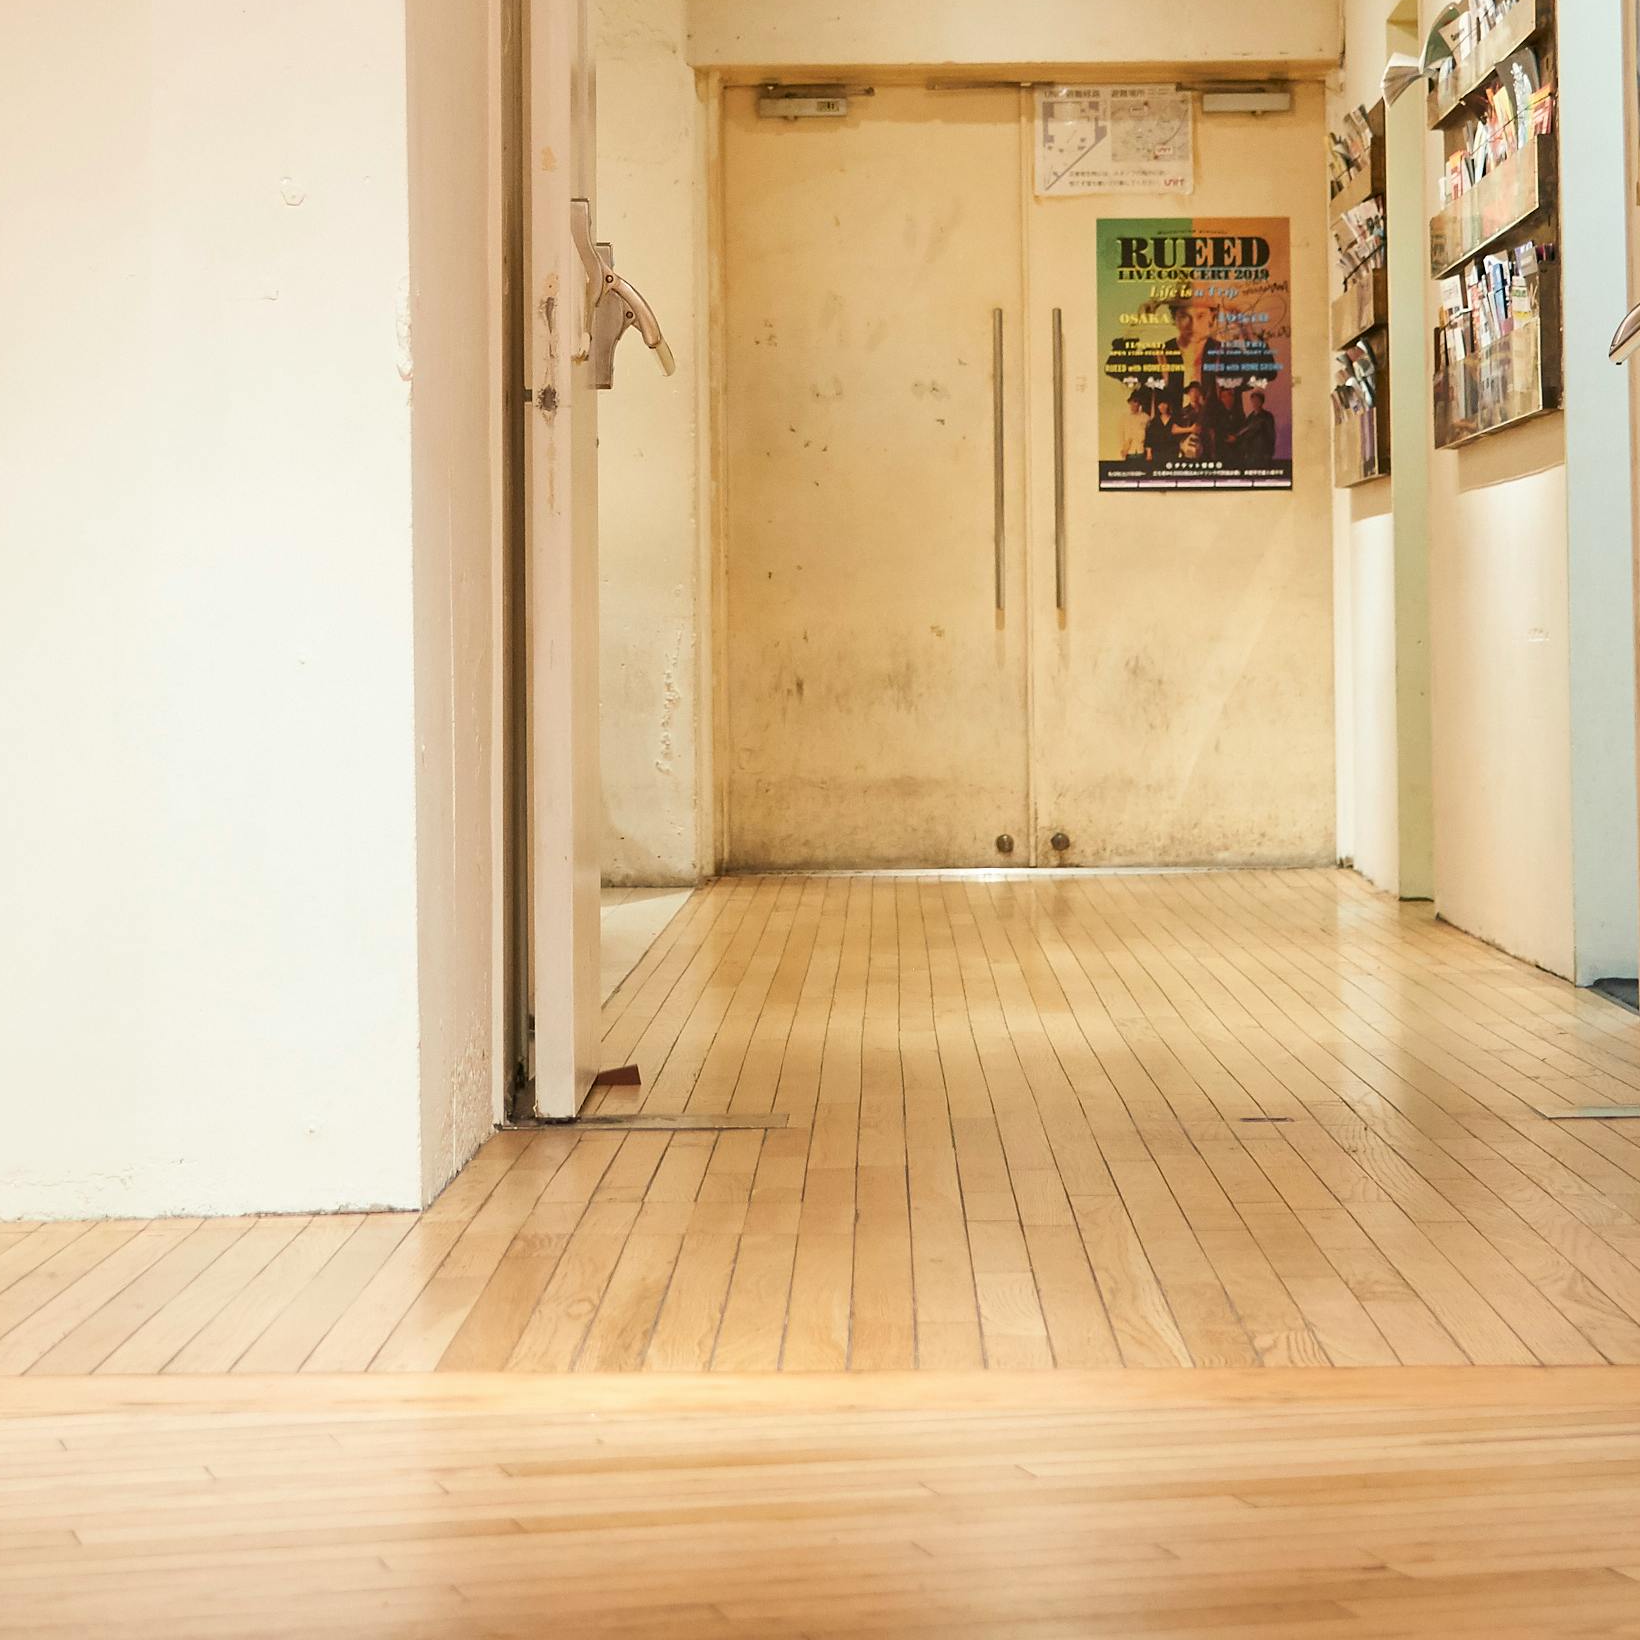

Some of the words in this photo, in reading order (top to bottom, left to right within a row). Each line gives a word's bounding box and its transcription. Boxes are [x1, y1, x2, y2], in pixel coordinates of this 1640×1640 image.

[1117, 237, 1270, 269] RUEED
[1234, 269, 1270, 281] 2019
[1150, 285, 1177, 299] Life
[1180, 284, 1192, 298] is
[1119, 312, 1171, 324] OSAKA
